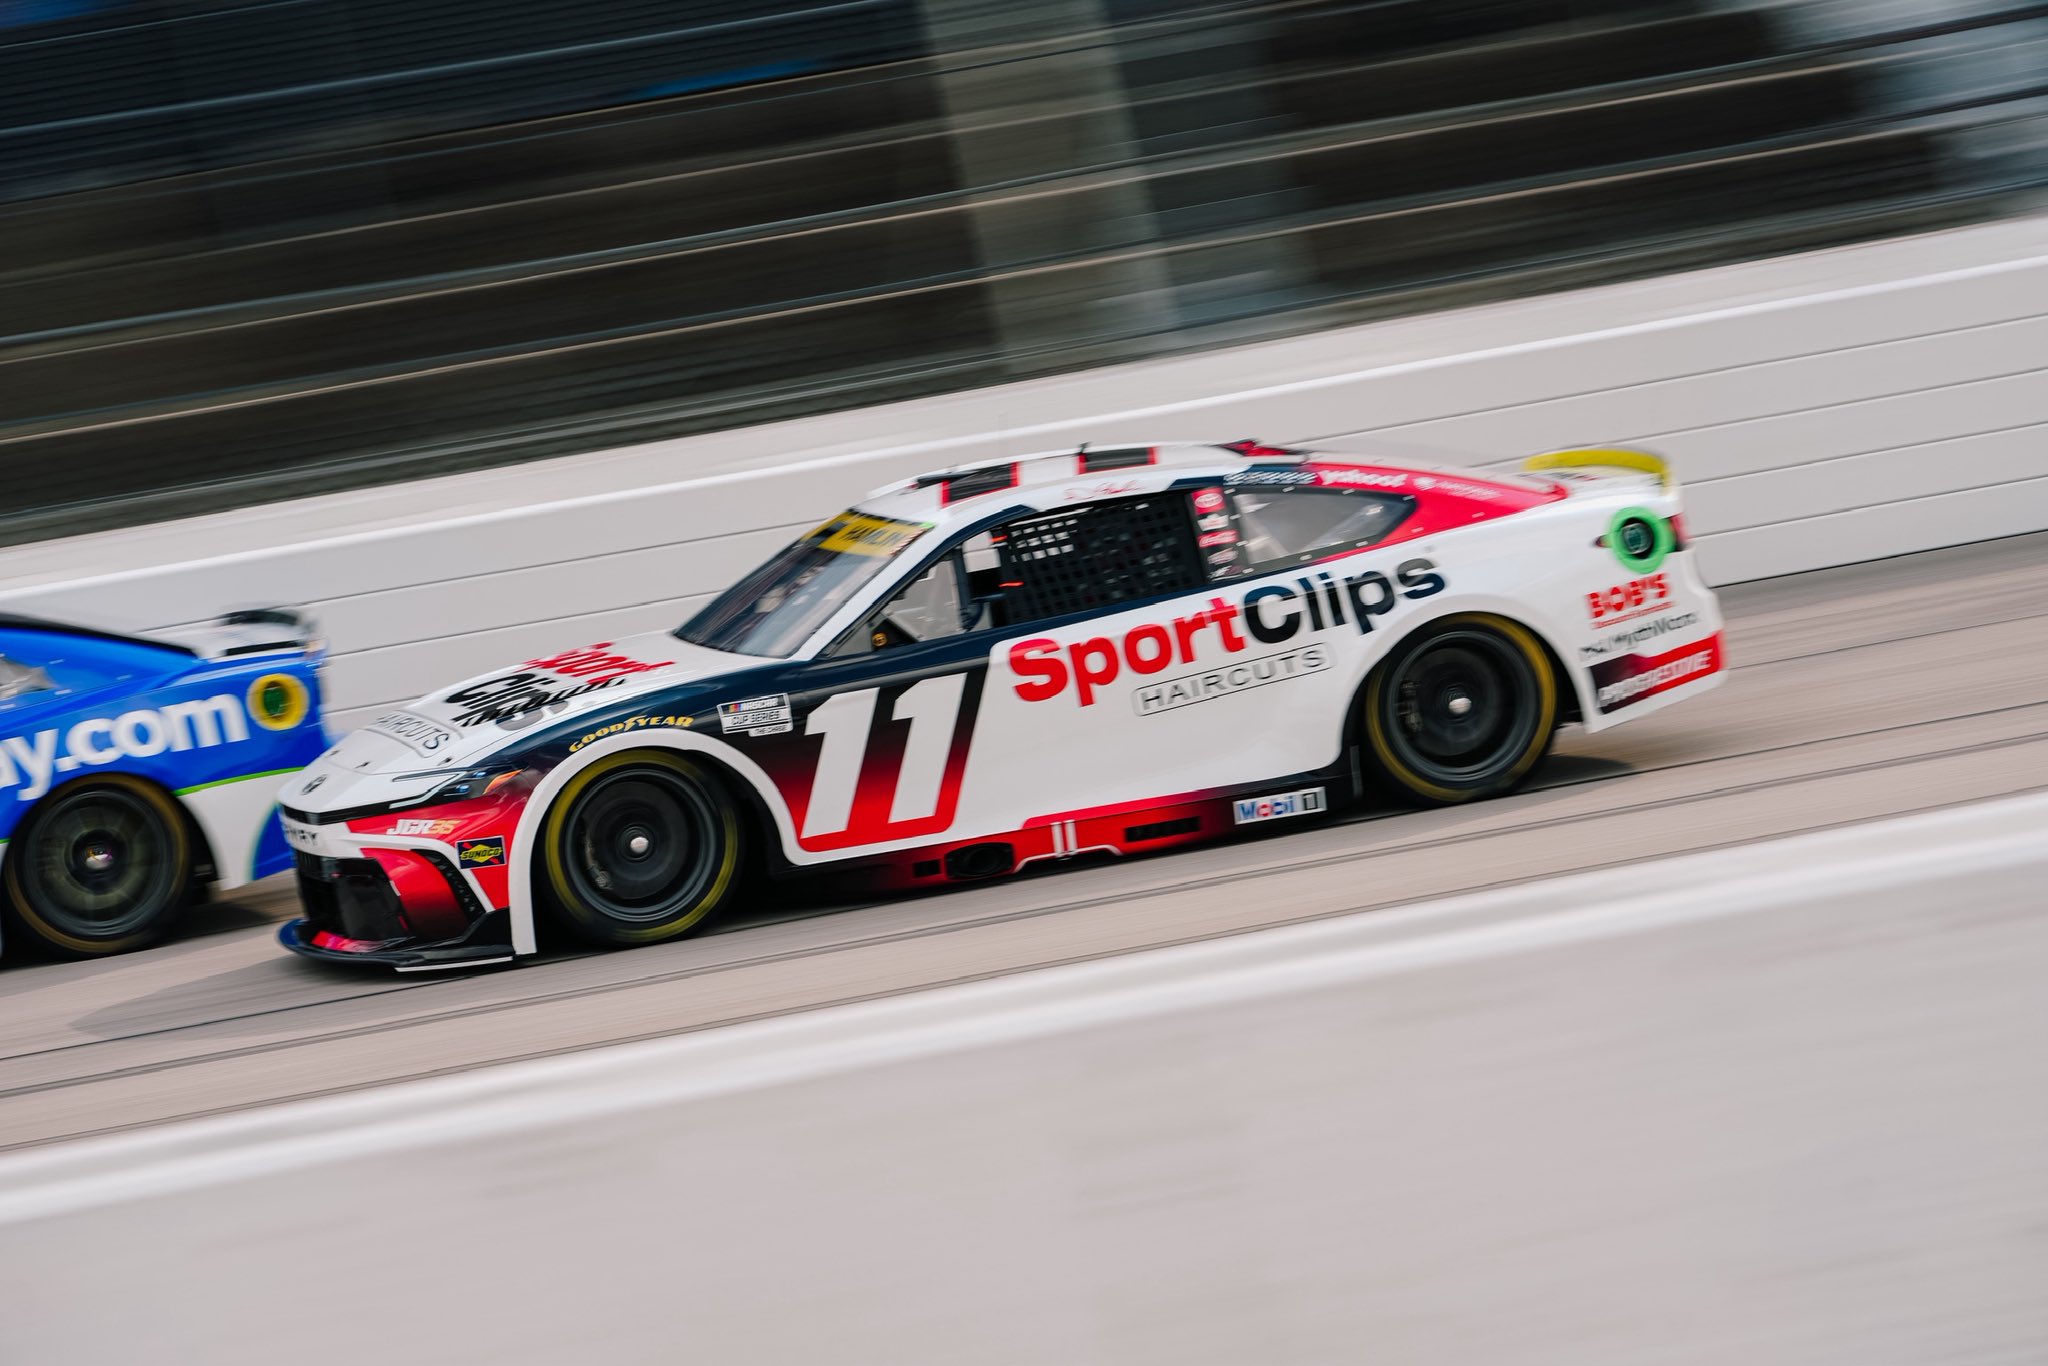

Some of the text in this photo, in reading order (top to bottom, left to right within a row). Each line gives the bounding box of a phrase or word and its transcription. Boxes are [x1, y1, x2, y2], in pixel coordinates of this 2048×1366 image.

[1141, 651, 1326, 711] HAIRCUTS
[568, 714, 696, 753] GOODYEAR
[733, 711, 780, 725] CUP SERIES
[0, 694, 251, 801] y.com
[801, 672, 968, 839] 11
[1239, 797, 1294, 819] Mobil
[460, 847, 503, 861] SUNOCO
